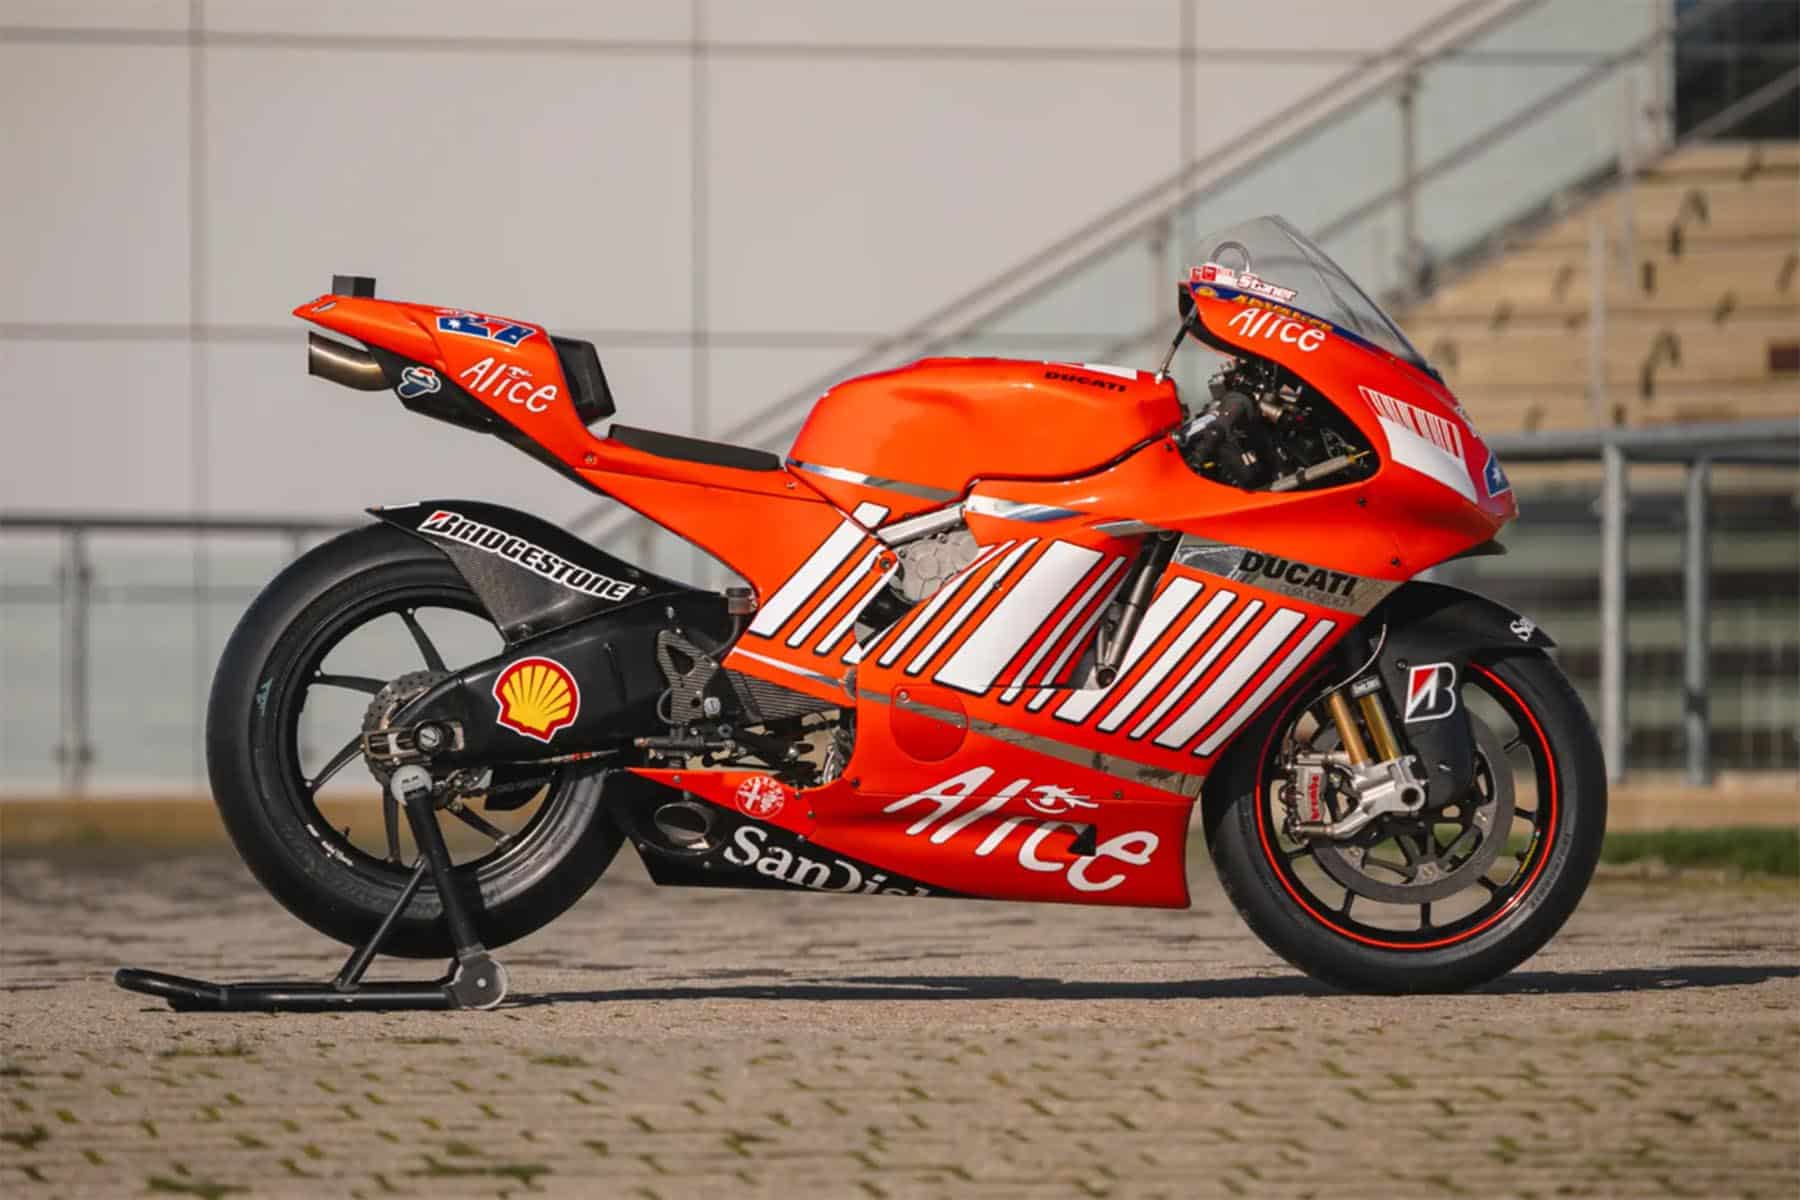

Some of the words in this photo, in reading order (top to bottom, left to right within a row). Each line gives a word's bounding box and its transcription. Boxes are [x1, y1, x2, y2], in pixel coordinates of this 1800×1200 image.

[1227, 307, 1327, 352] Alice
[459, 356, 558, 413] Alice
[1044, 370, 1127, 393] DUCATI
[416, 509, 637, 603] BRIDGESTONE
[1237, 550, 1360, 597] DUCATI
[881, 764, 1159, 893] Alice
[722, 825, 930, 898] SanDi
